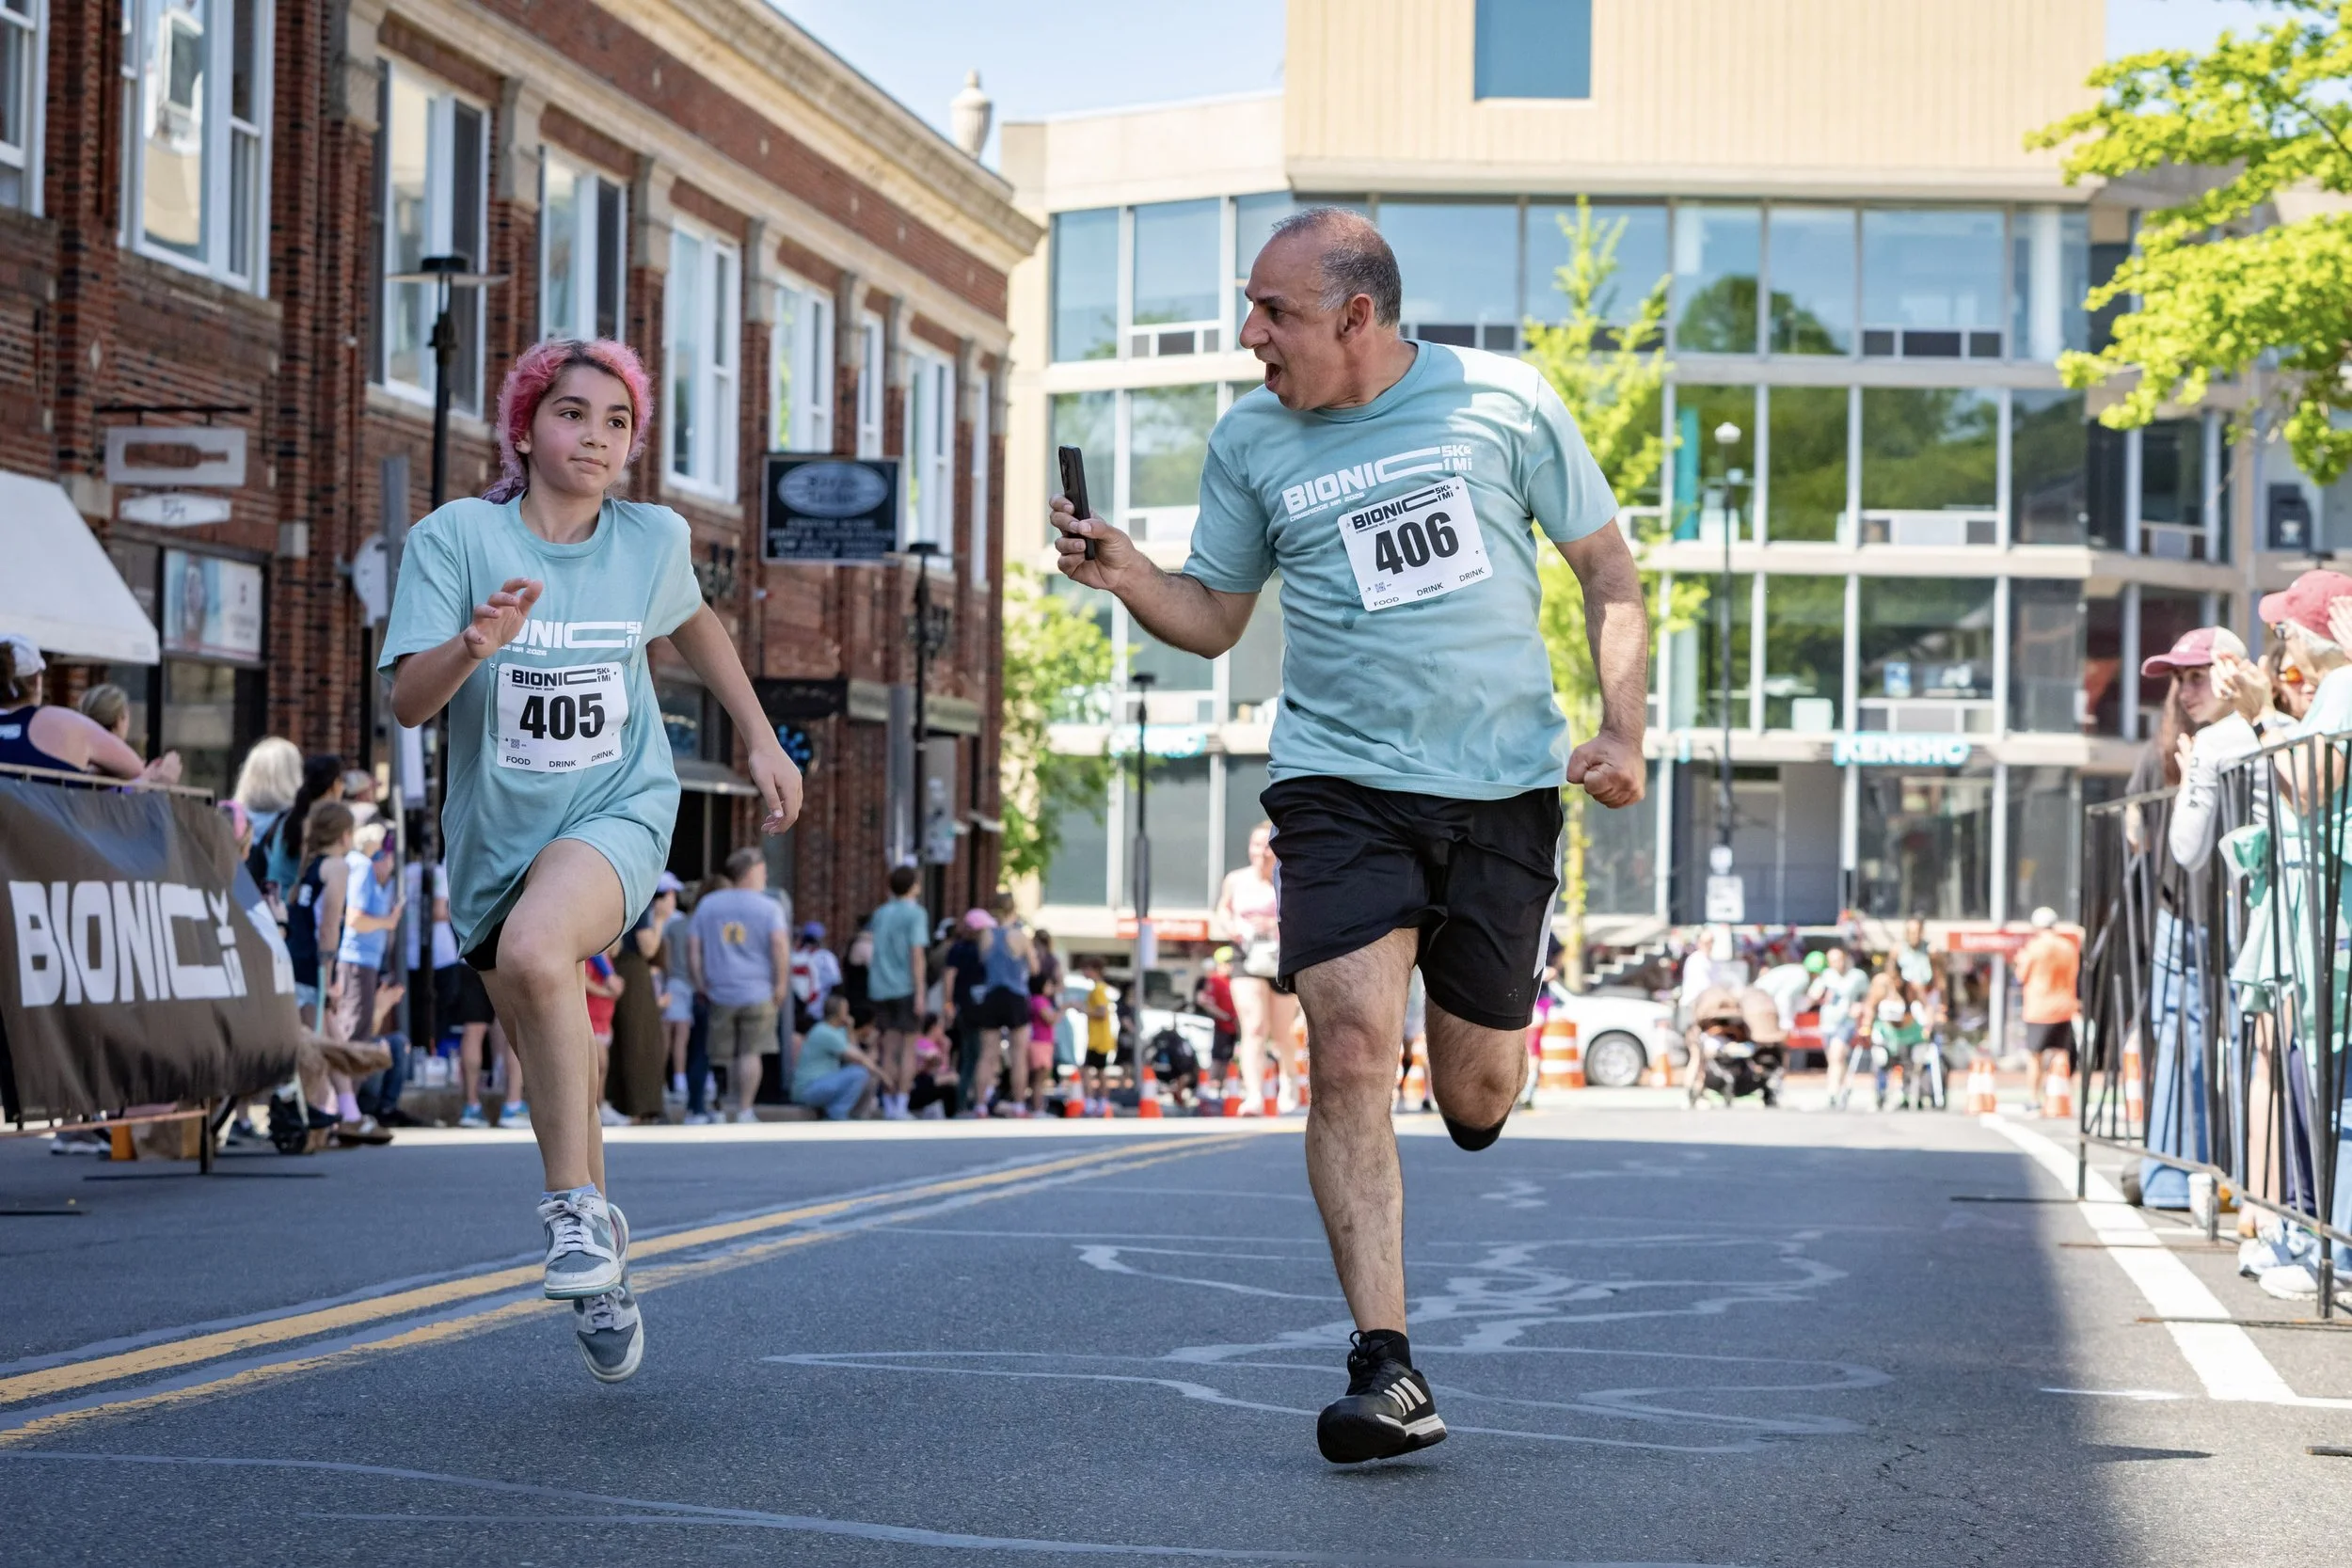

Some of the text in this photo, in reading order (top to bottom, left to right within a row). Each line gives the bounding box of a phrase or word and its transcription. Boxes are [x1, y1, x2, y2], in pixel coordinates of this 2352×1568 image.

[1282, 446, 1442, 515] BIONIC
[1290, 503, 1328, 522] CAMBRIDGE
[1351, 488, 1438, 531] BIONIC
[1375, 512, 1459, 576] 406
[1374, 567, 1485, 607] FOOD DRINK DRINK
[512, 619, 626, 649] ONIC
[512, 668, 597, 687] BIONIC
[519, 692, 606, 740] 405
[506, 755, 531, 766] FOOD
[591, 749, 614, 762] DRINK
[8, 880, 233, 1007] BIONIC
